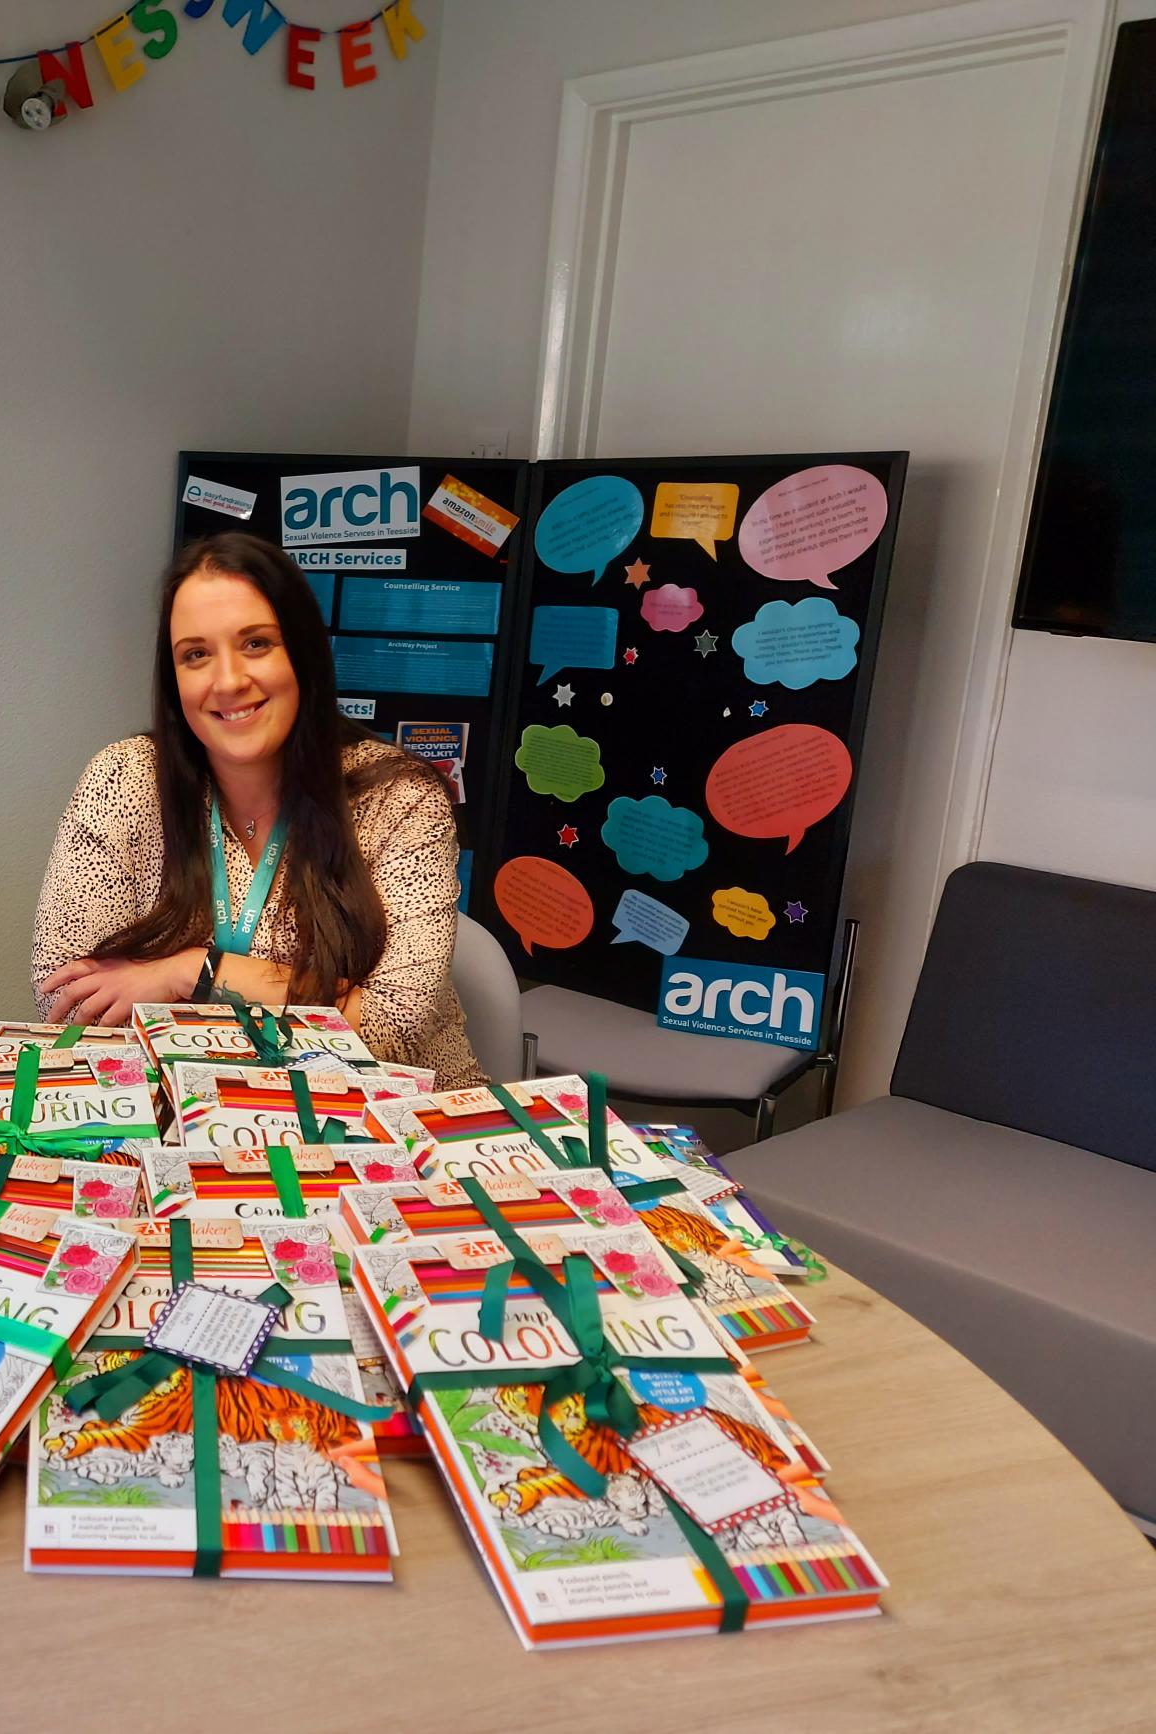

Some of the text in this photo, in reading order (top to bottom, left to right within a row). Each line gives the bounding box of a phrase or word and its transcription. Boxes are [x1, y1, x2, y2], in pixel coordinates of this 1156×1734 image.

[284, 472, 418, 530] arch
[442, 497, 497, 534] amazonsmile
[284, 533, 310, 542] Sexual
[311, 531, 342, 540] Violence
[344, 530, 376, 538] Services
[386, 527, 419, 536] Teesside
[335, 552, 402, 565] Services
[384, 582, 461, 592] Counselling Service
[416, 642, 438, 650] Project
[264, 842, 279, 866] arch
[216, 899, 227, 925] arch
[241, 908, 257, 934] arch
[665, 972, 814, 1033] arch
[169, 1031, 352, 1052] COLOING
[663, 1016, 812, 1046] Sexual Violence Services in Teesside
